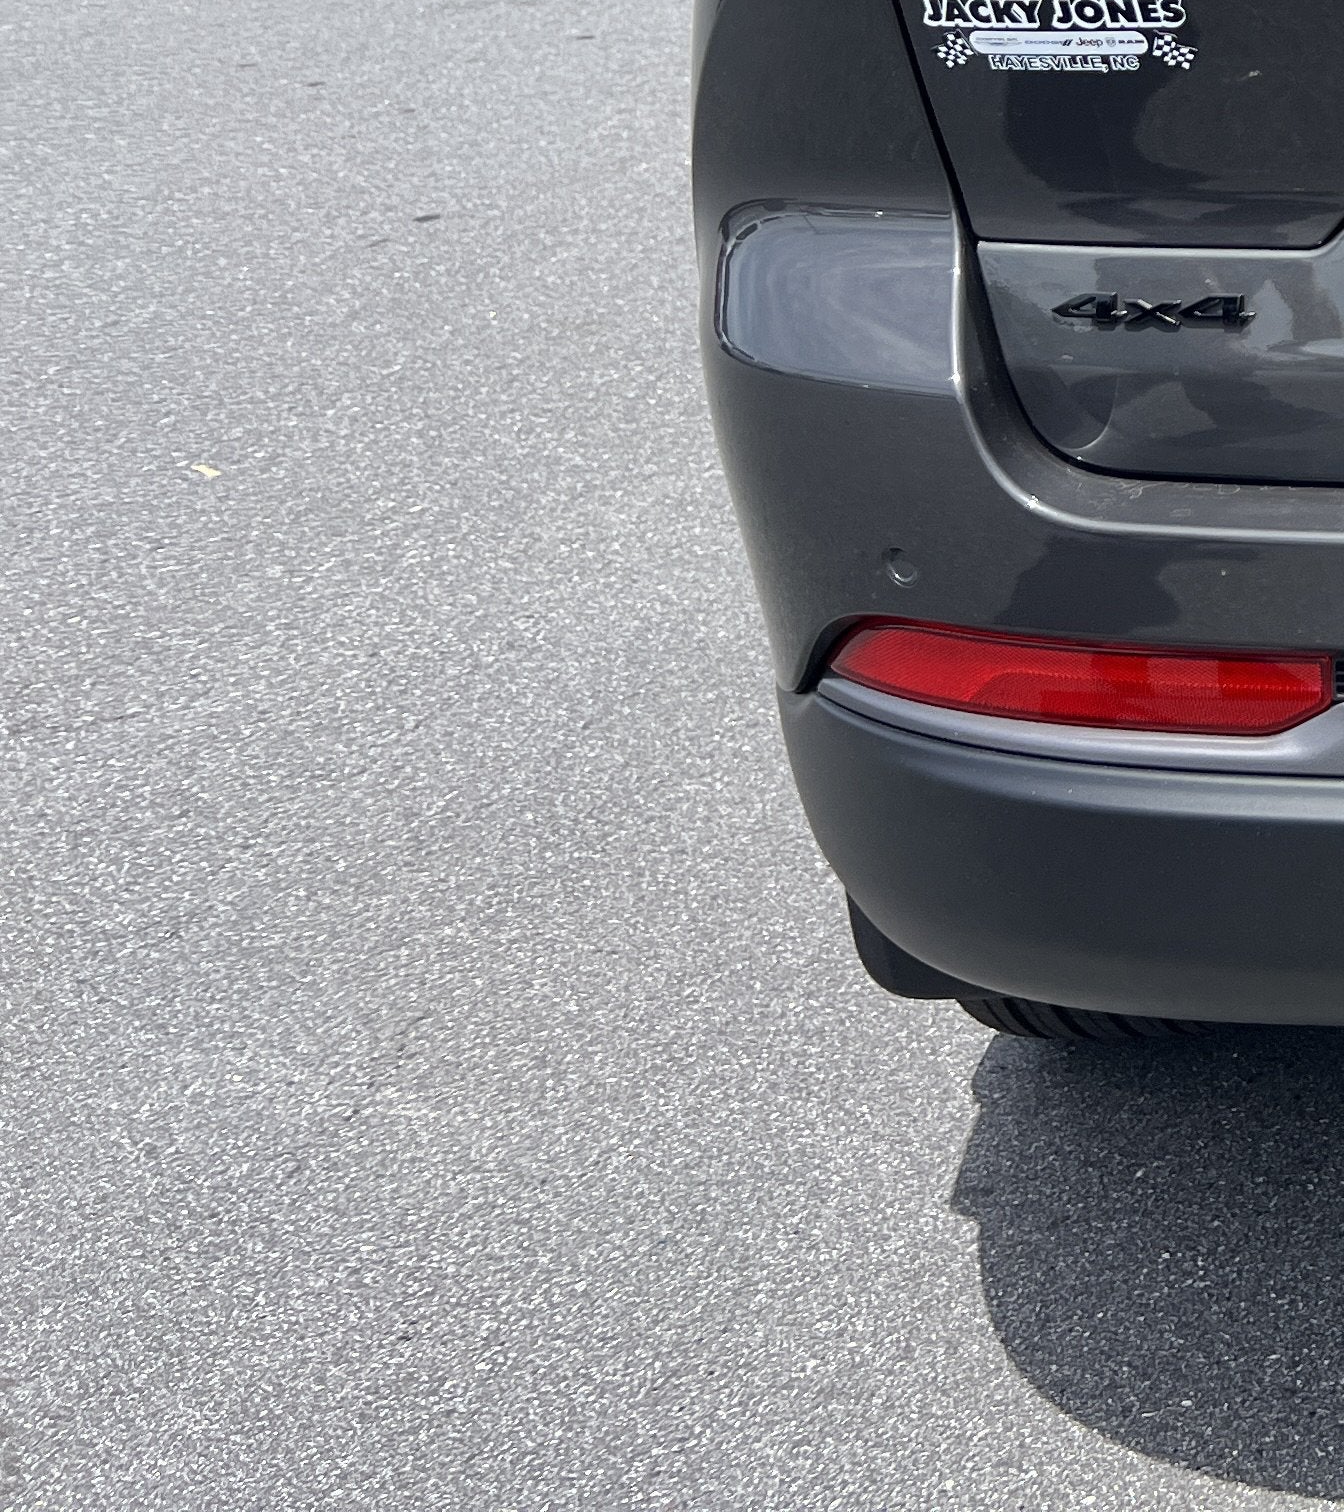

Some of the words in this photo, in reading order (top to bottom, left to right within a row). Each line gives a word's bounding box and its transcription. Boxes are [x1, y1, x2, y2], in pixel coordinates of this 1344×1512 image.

[1075, 37, 1103, 49] Jeep
[988, 55, 1109, 73] HAYESVILLE,
[1111, 55, 1140, 71] NC
[1051, 292, 1257, 330] 4x4
